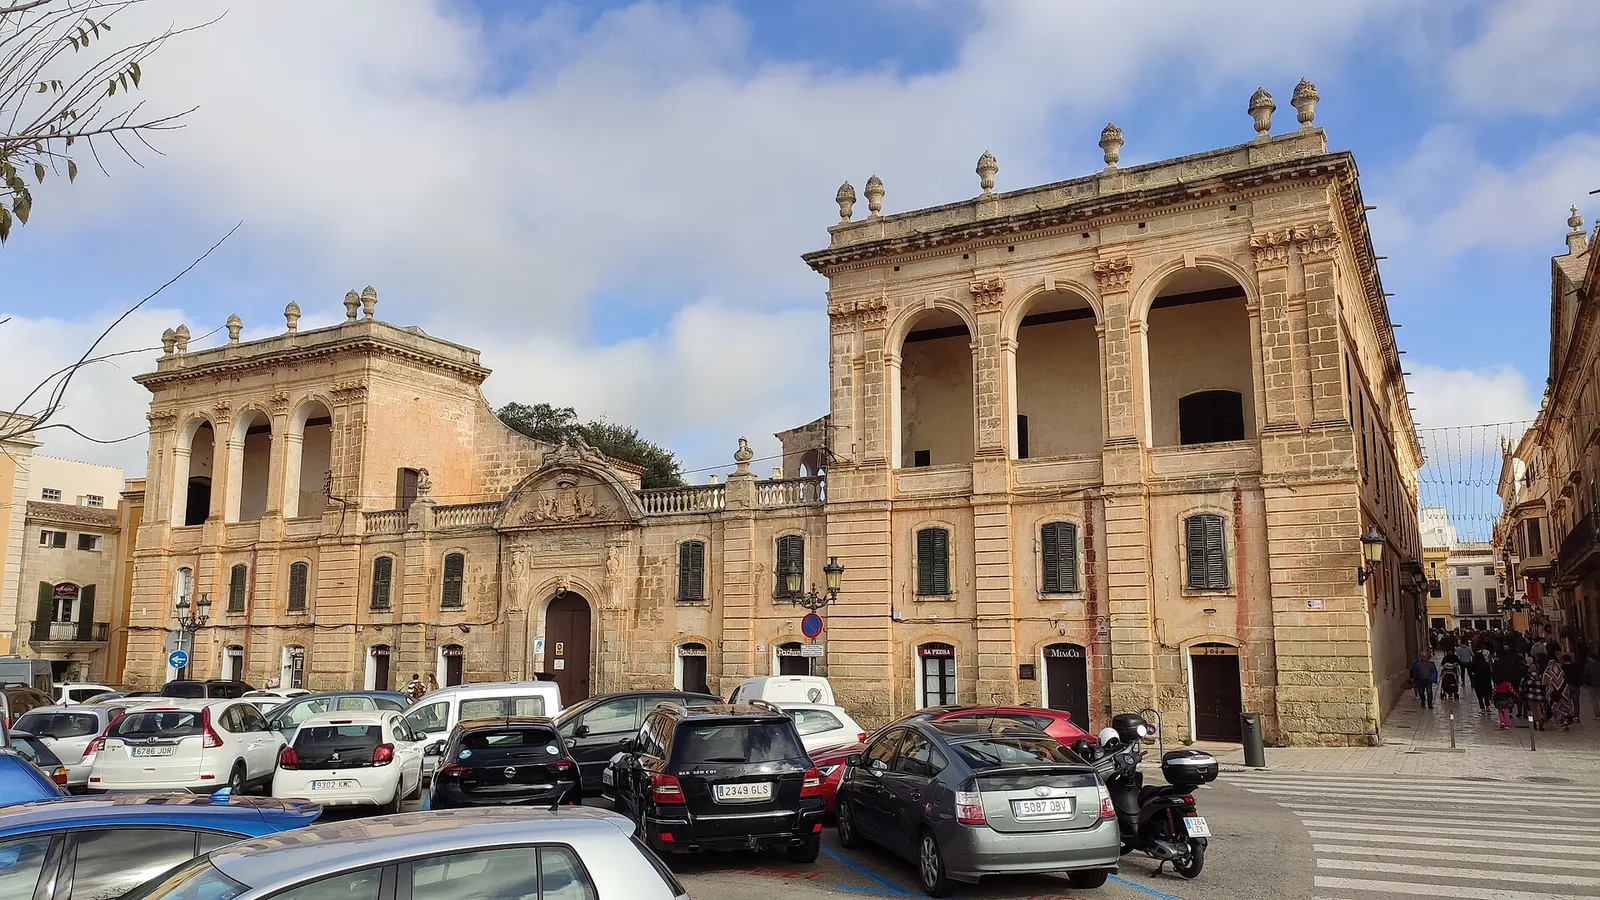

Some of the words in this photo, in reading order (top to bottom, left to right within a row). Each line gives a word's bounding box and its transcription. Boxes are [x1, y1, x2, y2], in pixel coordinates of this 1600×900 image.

[136, 747, 156, 755] 6786
[158, 746, 172, 755] JDR
[725, 786, 749, 796] 2349
[751, 785, 769, 795] GLS
[1023, 801, 1047, 812] 5087
[1049, 800, 1066, 812] DBV
